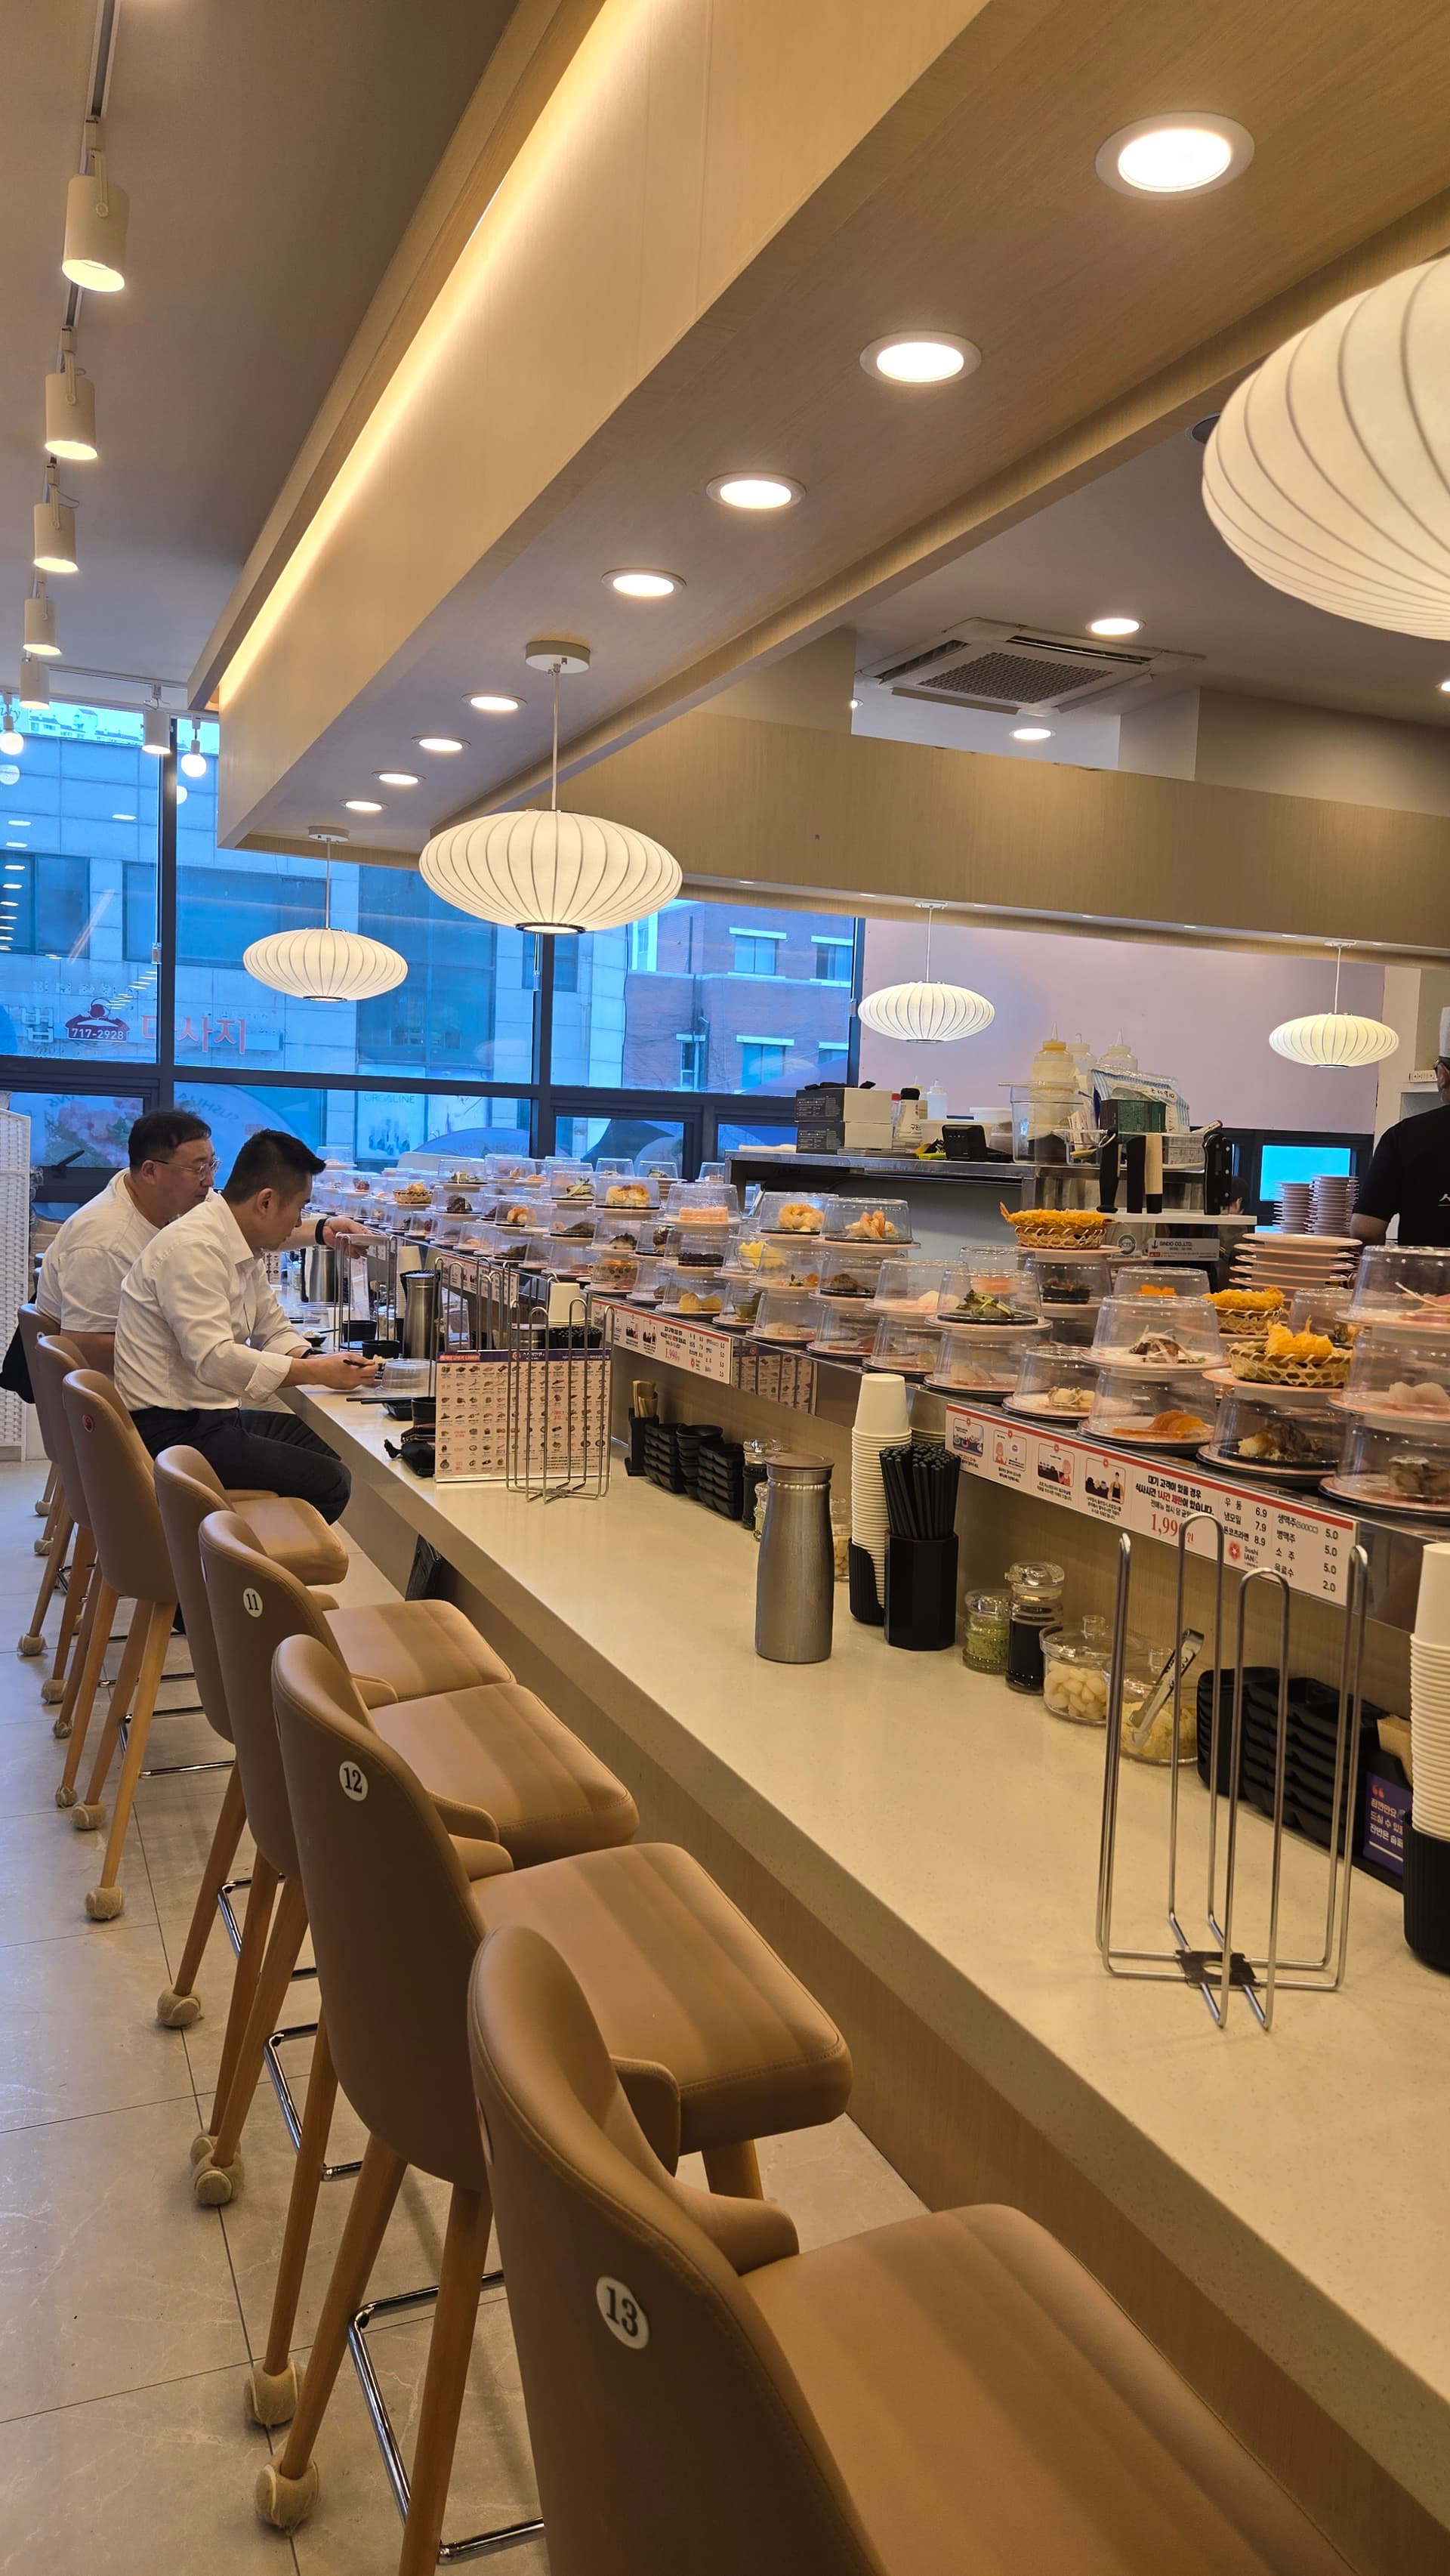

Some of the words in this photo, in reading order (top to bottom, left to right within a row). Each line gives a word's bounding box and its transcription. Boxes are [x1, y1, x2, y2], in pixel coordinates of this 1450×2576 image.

[71, 1027, 125, 1040] 717-2928
[1135, 1483, 1157, 1497] 식사시간
[1148, 1475, 1159, 1487] 대기
[1160, 1478, 1177, 1493] 고객이
[1177, 1482, 1189, 1496] 있을
[1189, 1487, 1202, 1500] 경우
[1255, 1507, 1268, 1518] 6.9
[1223, 1511, 1242, 1525] 냉모밀
[1254, 1521, 1267, 1532] 7.9
[1254, 1535, 1266, 1546] 8.9
[1325, 1528, 1339, 1540] 5.0
[1276, 1530, 1296, 1543] 병맥주
[1324, 1545, 1338, 1557] 5.0
[1323, 1562, 1337, 1575] 5.0
[1274, 1562, 1294, 1578] 음료수
[1322, 1580, 1336, 1592] 2.0
[245, 1593, 260, 1611] 11
[344, 1767, 362, 1794] 12
[1384, 1818, 1392, 1829] 수
[606, 2284, 639, 2338] 13
